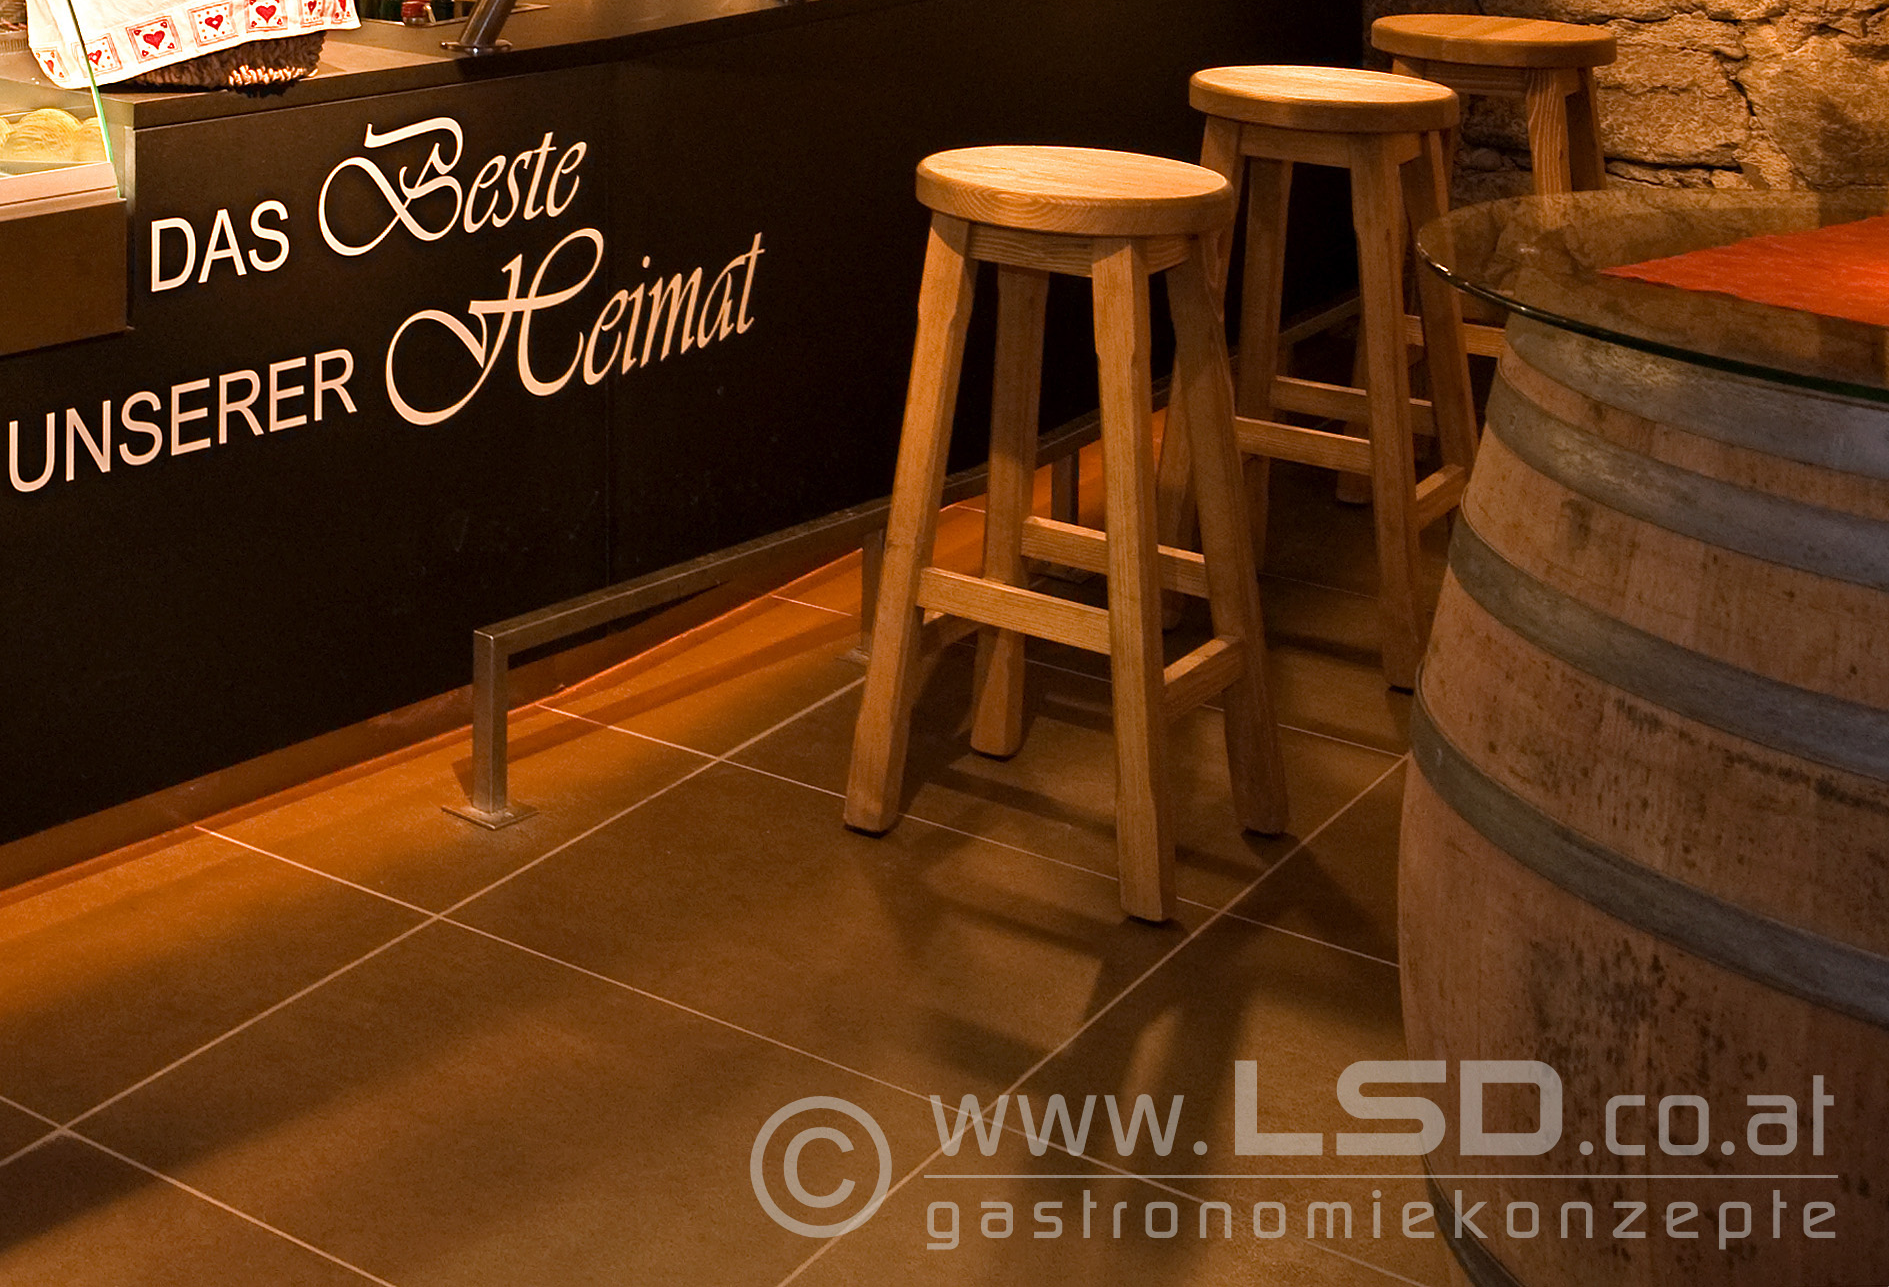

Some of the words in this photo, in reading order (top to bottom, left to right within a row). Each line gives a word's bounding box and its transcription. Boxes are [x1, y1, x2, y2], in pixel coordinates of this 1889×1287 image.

[149, 199, 291, 293] DAS
[317, 115, 588, 257] Beste
[7, 348, 358, 493] UNSERER
[384, 227, 766, 427] Heimat
